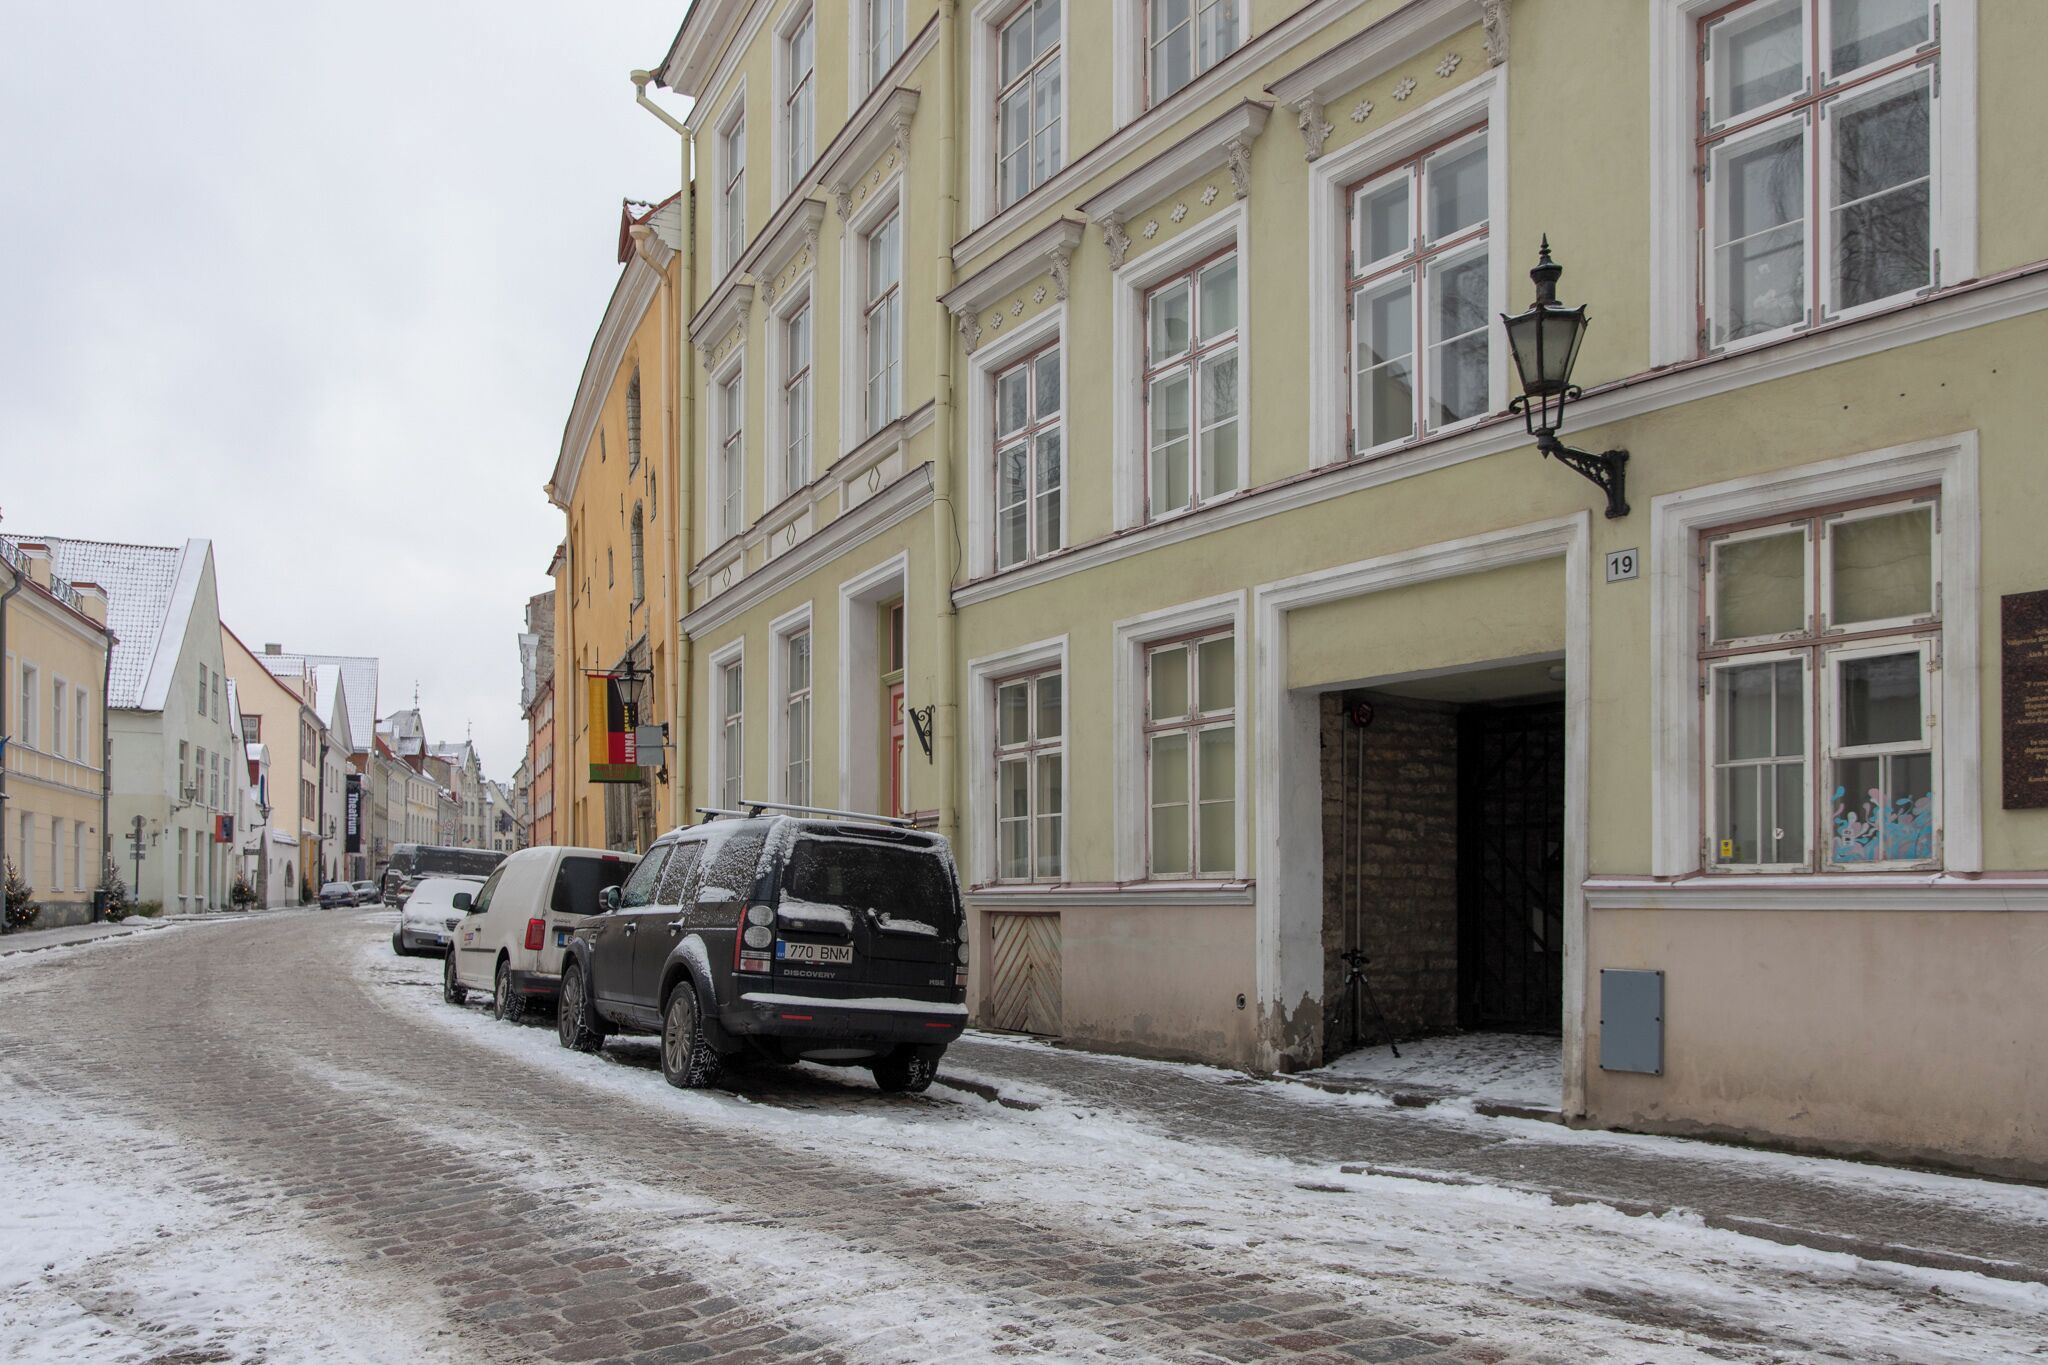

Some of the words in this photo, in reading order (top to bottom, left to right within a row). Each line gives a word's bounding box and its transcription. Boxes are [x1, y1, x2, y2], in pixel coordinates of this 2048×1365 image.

[1611, 556, 1632, 575] 19
[348, 792, 358, 835] Theatrum
[790, 945, 813, 959] 770
[820, 947, 850, 961] BNM
[783, 969, 836, 979] DISCOVERY
